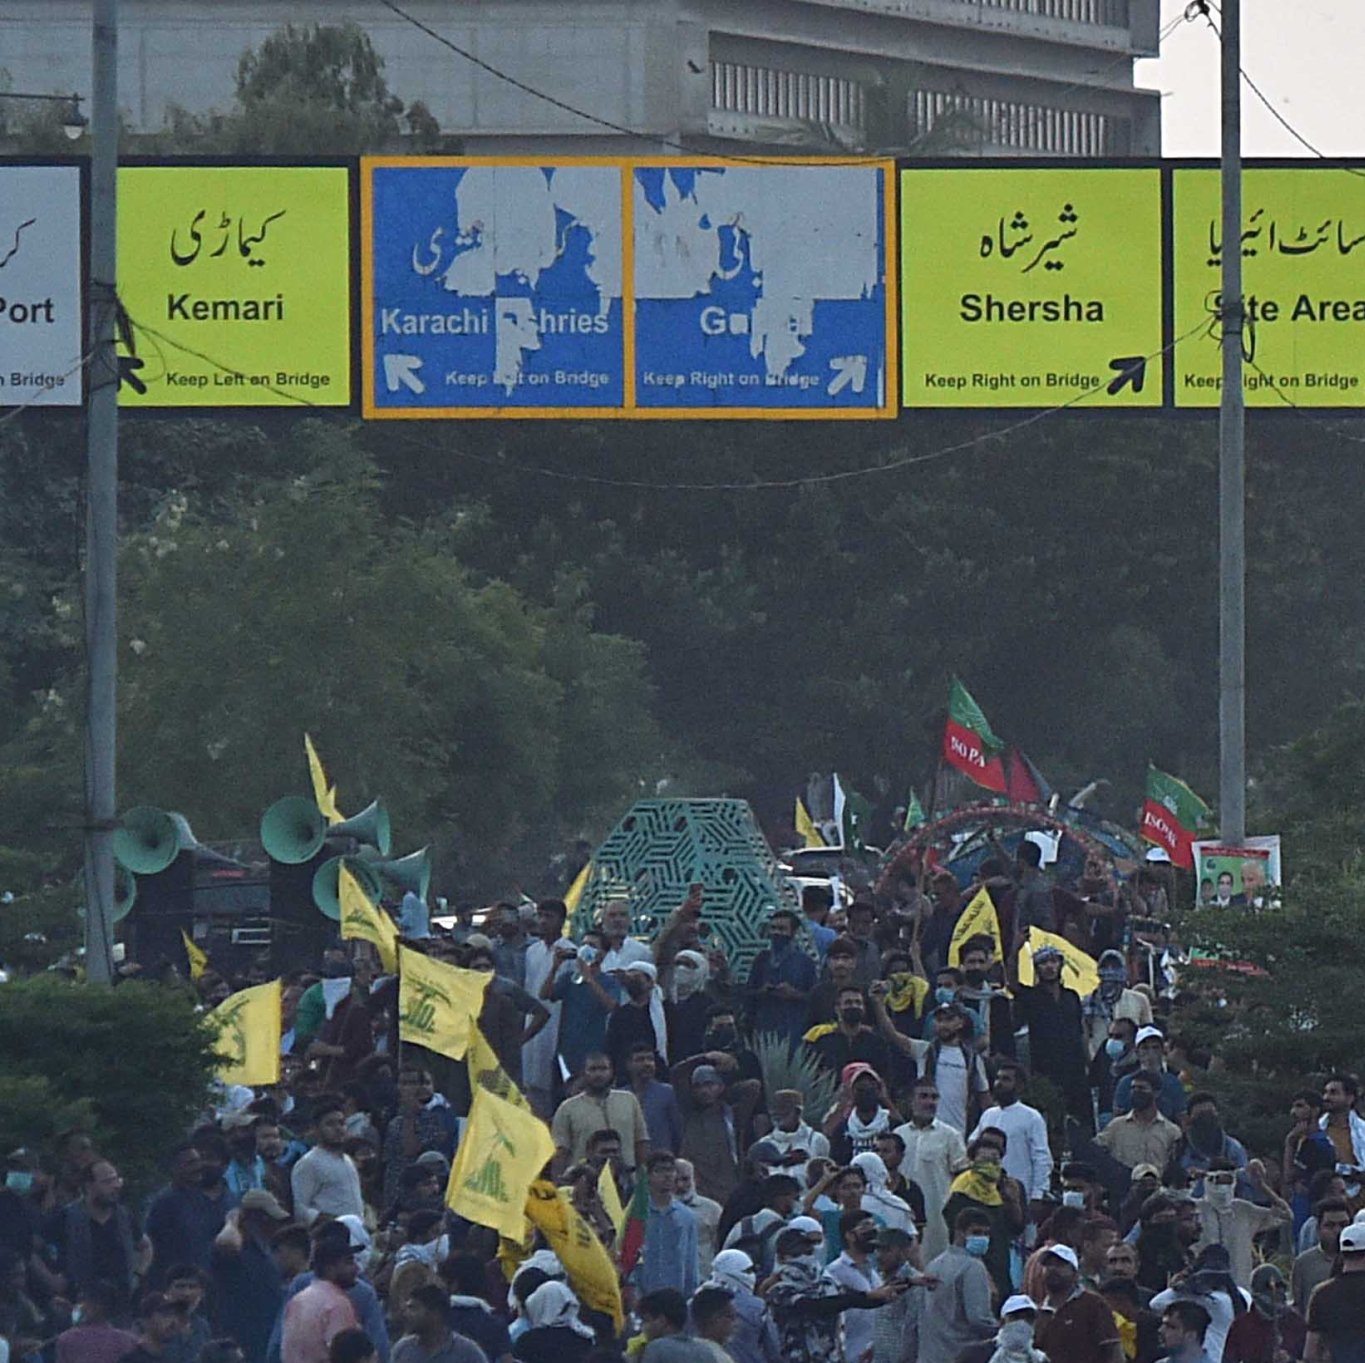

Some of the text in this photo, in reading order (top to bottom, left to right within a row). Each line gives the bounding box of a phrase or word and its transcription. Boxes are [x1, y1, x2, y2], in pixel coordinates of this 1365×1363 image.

[0, 298, 54, 324] ort
[167, 294, 284, 321] Kemari
[959, 294, 1105, 323] Shersha
[381, 308, 488, 335] Karachi
[10, 372, 65, 390] Bridge
[166, 373, 331, 390] Keep Left on Bridge
[446, 371, 488, 389] Keep
[528, 374, 550, 386] on
[643, 371, 686, 389] Keep
[691, 371, 735, 390] Right
[738, 374, 760, 386] on
[925, 373, 1100, 390] Keep Right on Bridge
[1243, 373, 1275, 390] ight
[1279, 377, 1300, 388] on
[1305, 373, 1359, 390] Bridge
